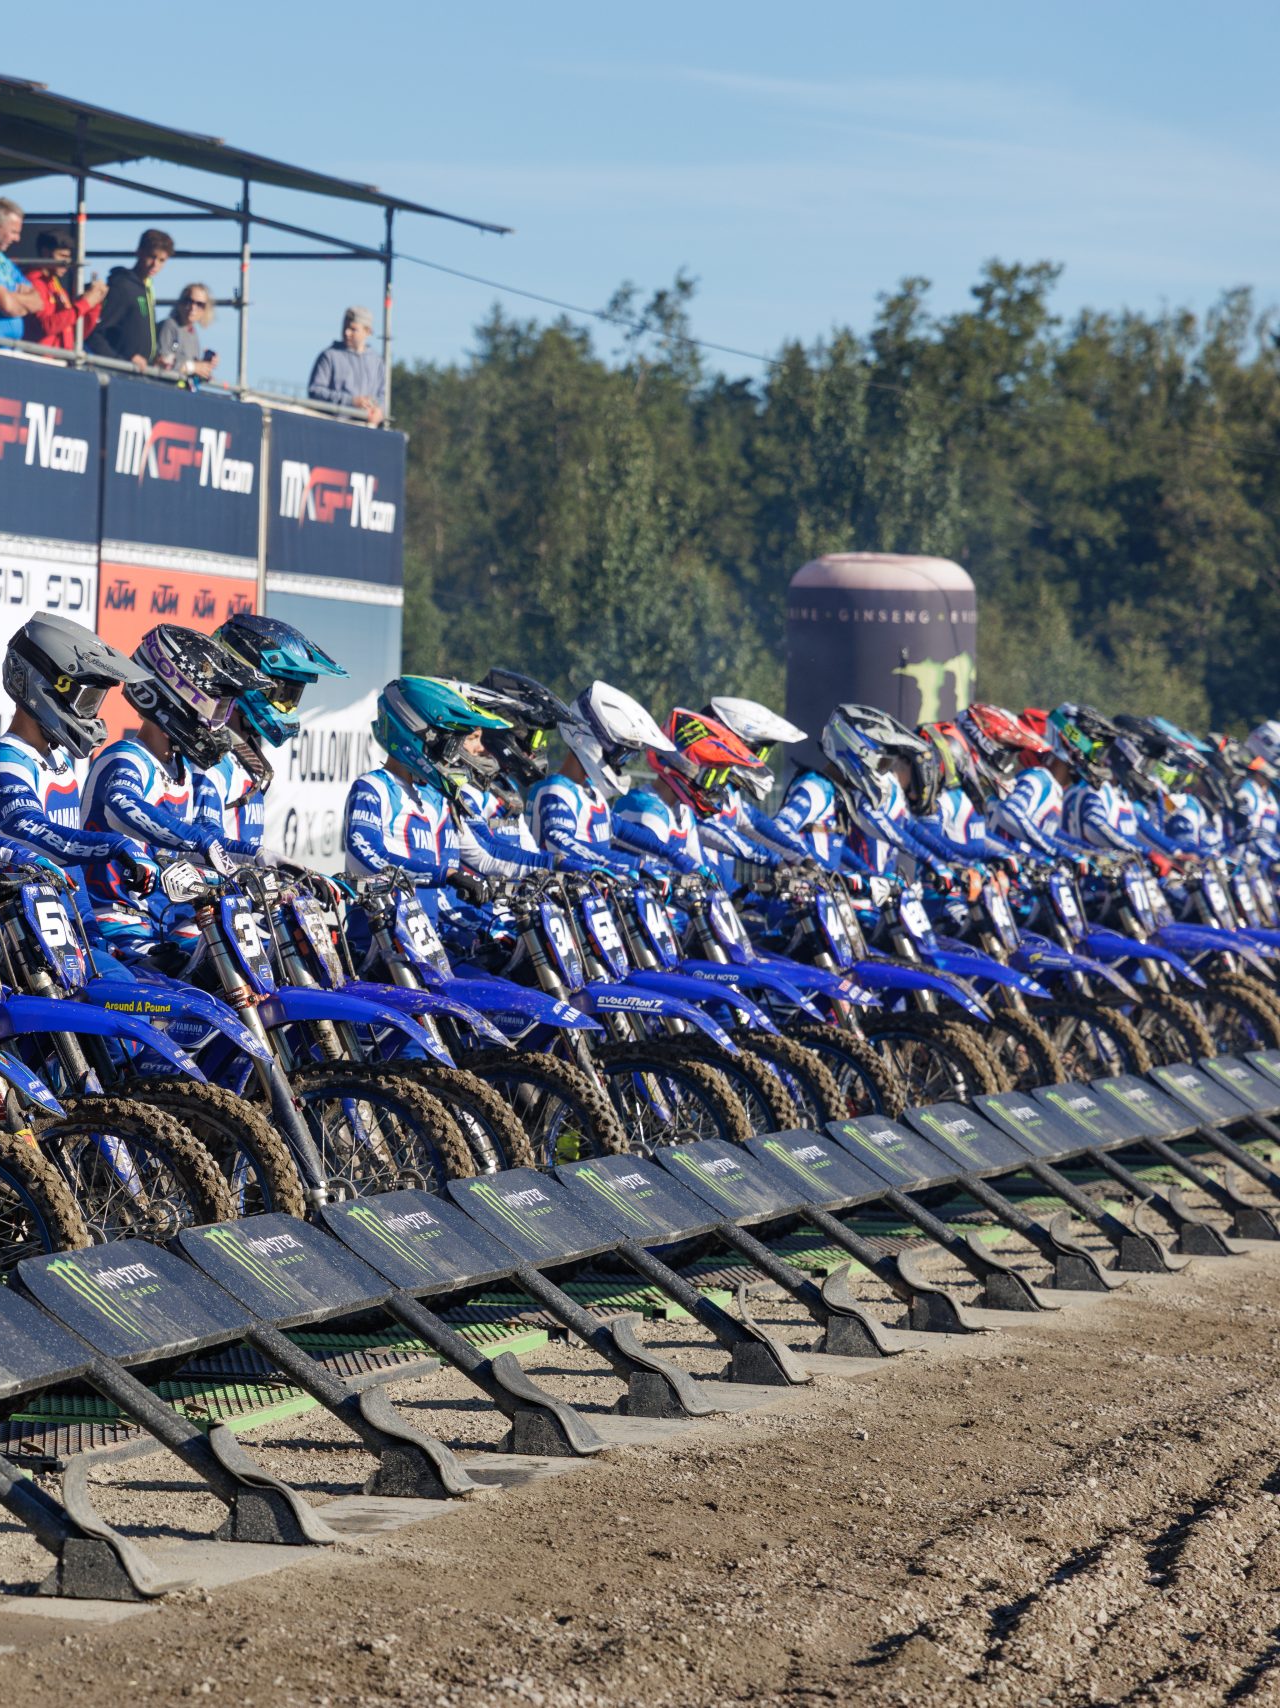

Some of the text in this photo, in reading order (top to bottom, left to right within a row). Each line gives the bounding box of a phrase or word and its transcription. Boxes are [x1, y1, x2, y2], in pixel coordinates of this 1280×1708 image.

[104, 579, 136, 611] KTM
[150, 585, 178, 615] KTM
[192, 589, 216, 619] KTM
[837, 608, 930, 624] GINSENG
[143, 633, 208, 705] SCOTT
[289, 728, 353, 782] FOLLOW
[47, 807, 81, 829] YAMAH
[104, 1001, 171, 1013] Around A Pound
[500, 1187, 550, 1208] MONSTER
[382, 1211, 437, 1234] MONSTER
[244, 1233, 304, 1257] MONSTER
[93, 1262, 158, 1289] MONSTER
